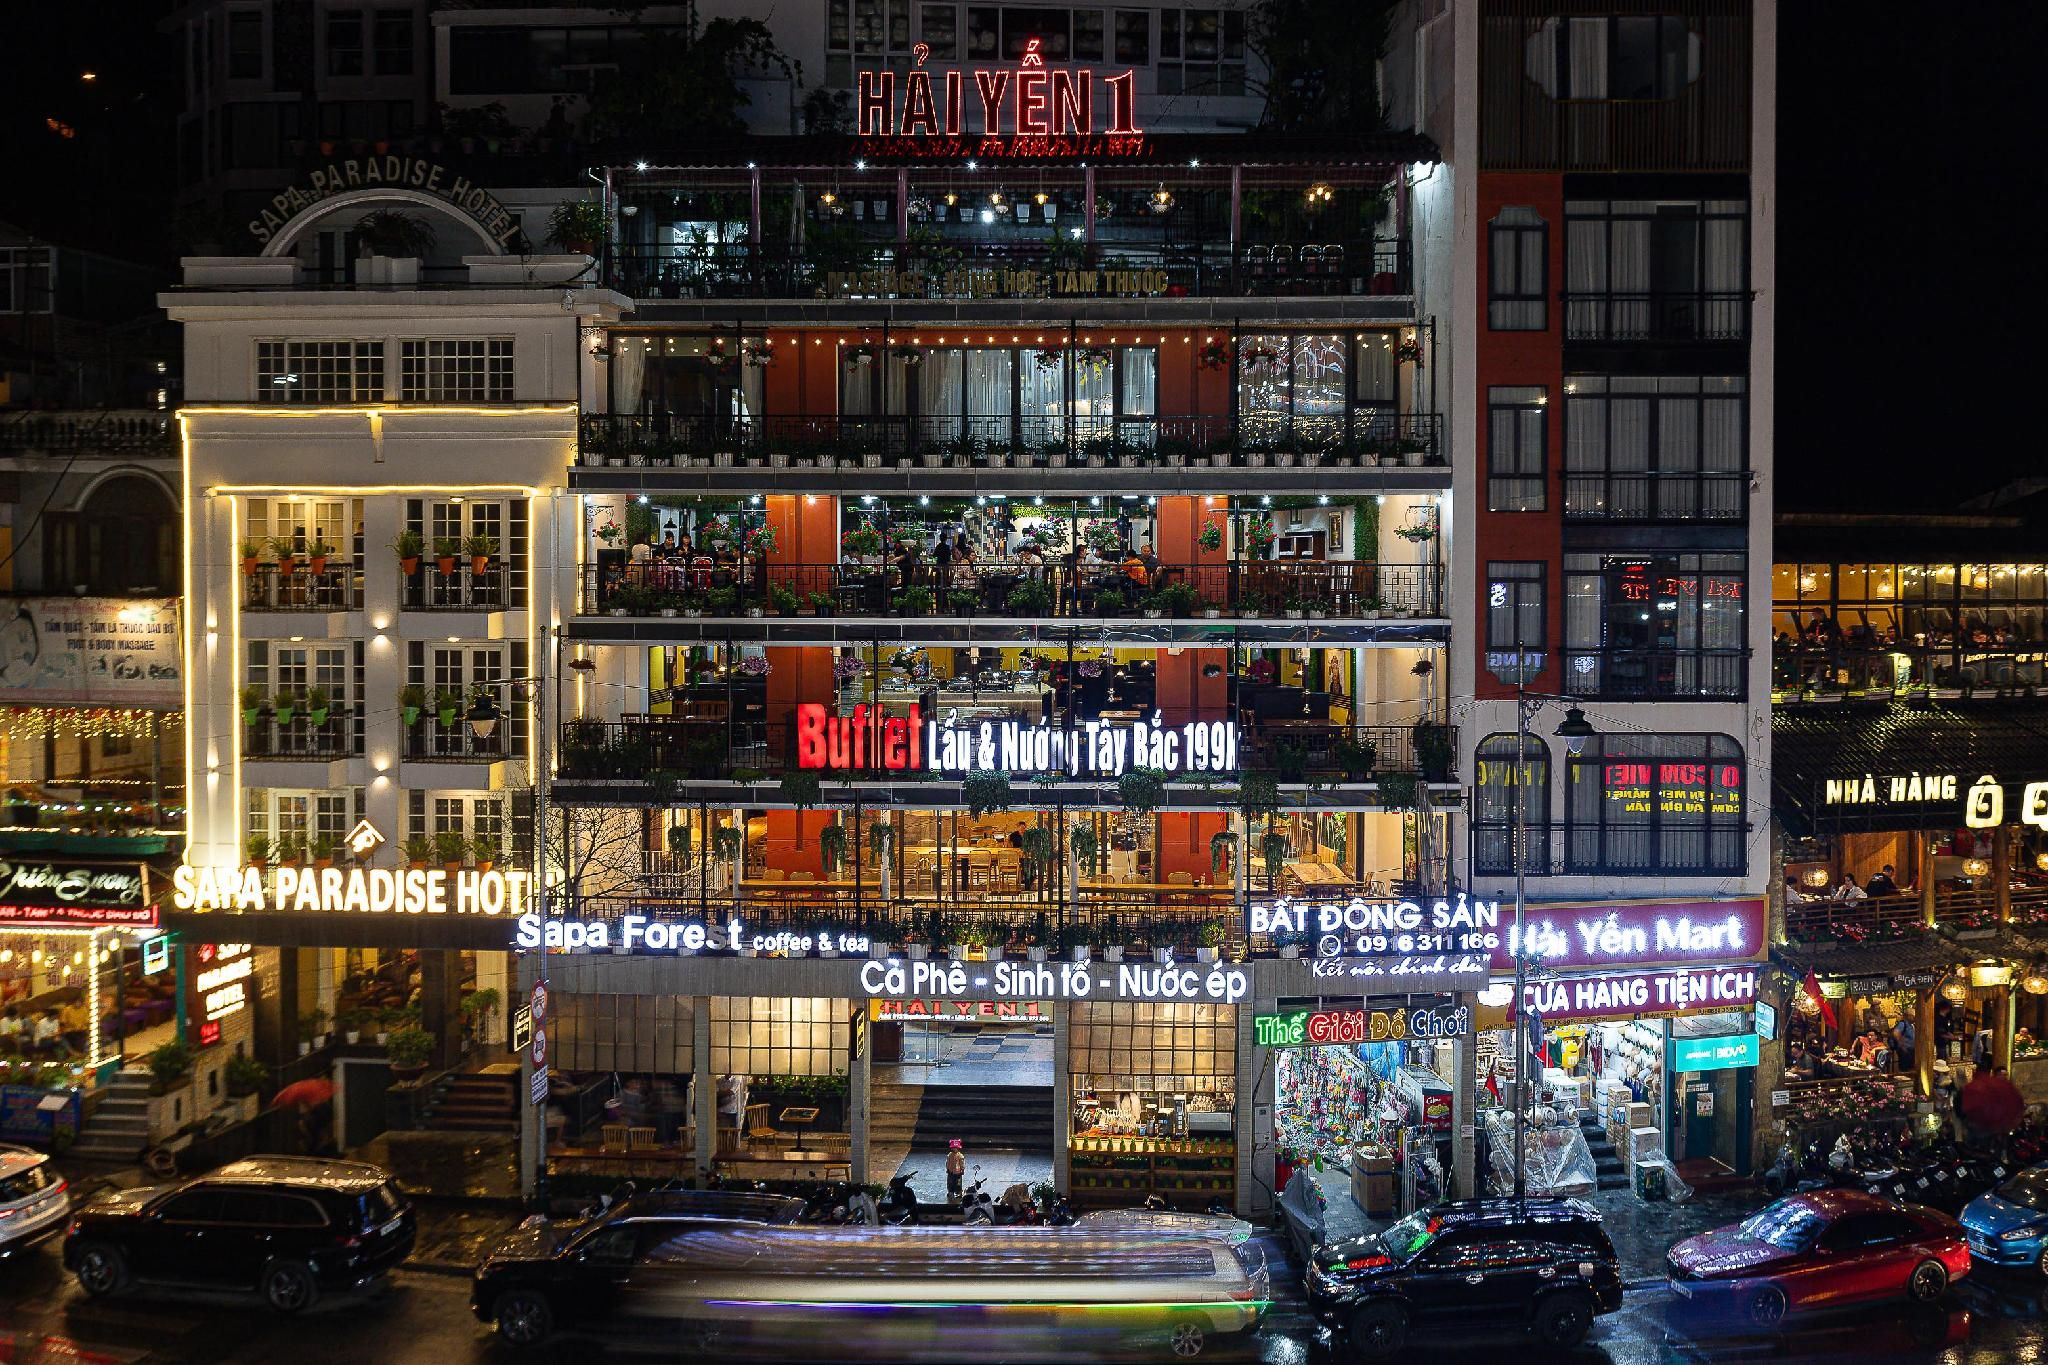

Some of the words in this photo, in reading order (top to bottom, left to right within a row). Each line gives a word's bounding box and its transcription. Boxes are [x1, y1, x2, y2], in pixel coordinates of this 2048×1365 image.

[858, 43, 961, 136] HẢI
[975, 39, 1092, 136] YẾN
[1104, 69, 1143, 135] 1
[249, 185, 303, 243] SAPA
[310, 155, 445, 195] PARADISE
[447, 175, 522, 247] HOTEL
[797, 703, 922, 769] Buffet
[928, 708, 970, 771] Lẩu
[978, 719, 996, 770] &
[1085, 717, 1127, 776] Tây
[1133, 709, 1179, 770] Bắc
[1826, 773, 1876, 805] NHÀ
[1889, 771, 1957, 802] HÀNG
[1965, 774, 2004, 828] Ô
[173, 865, 266, 911] SAPA
[275, 866, 447, 913] PARADISE
[516, 913, 609, 954] Sapa
[623, 915, 743, 950] Forest
[752, 932, 812, 952] coffee
[818, 932, 833, 952] &
[839, 931, 869, 952] tea
[1250, 895, 1309, 933] BẤT
[1432, 893, 1498, 929] SẢN
[1577, 911, 1648, 954] Yến
[1655, 914, 1745, 952] Mart
[1459, 932, 1500, 950] 166
[860, 957, 905, 995] Cà
[914, 961, 967, 995] Phê
[994, 962, 1055, 996] Sinh
[1061, 958, 1092, 996] tố
[1119, 960, 1200, 997] Nước
[1206, 959, 1248, 1003] ép
[1575, 977, 1649, 1010] HÀNG
[1655, 970, 1707, 1009] TIỆN
[1713, 967, 1755, 1002] ÍCH
[1255, 1012, 1307, 1045] Thế
[1308, 1012, 1364, 1042] Giới
[1370, 1008, 1406, 1040] Đồ
[1410, 1006, 1468, 1037] Chơi
